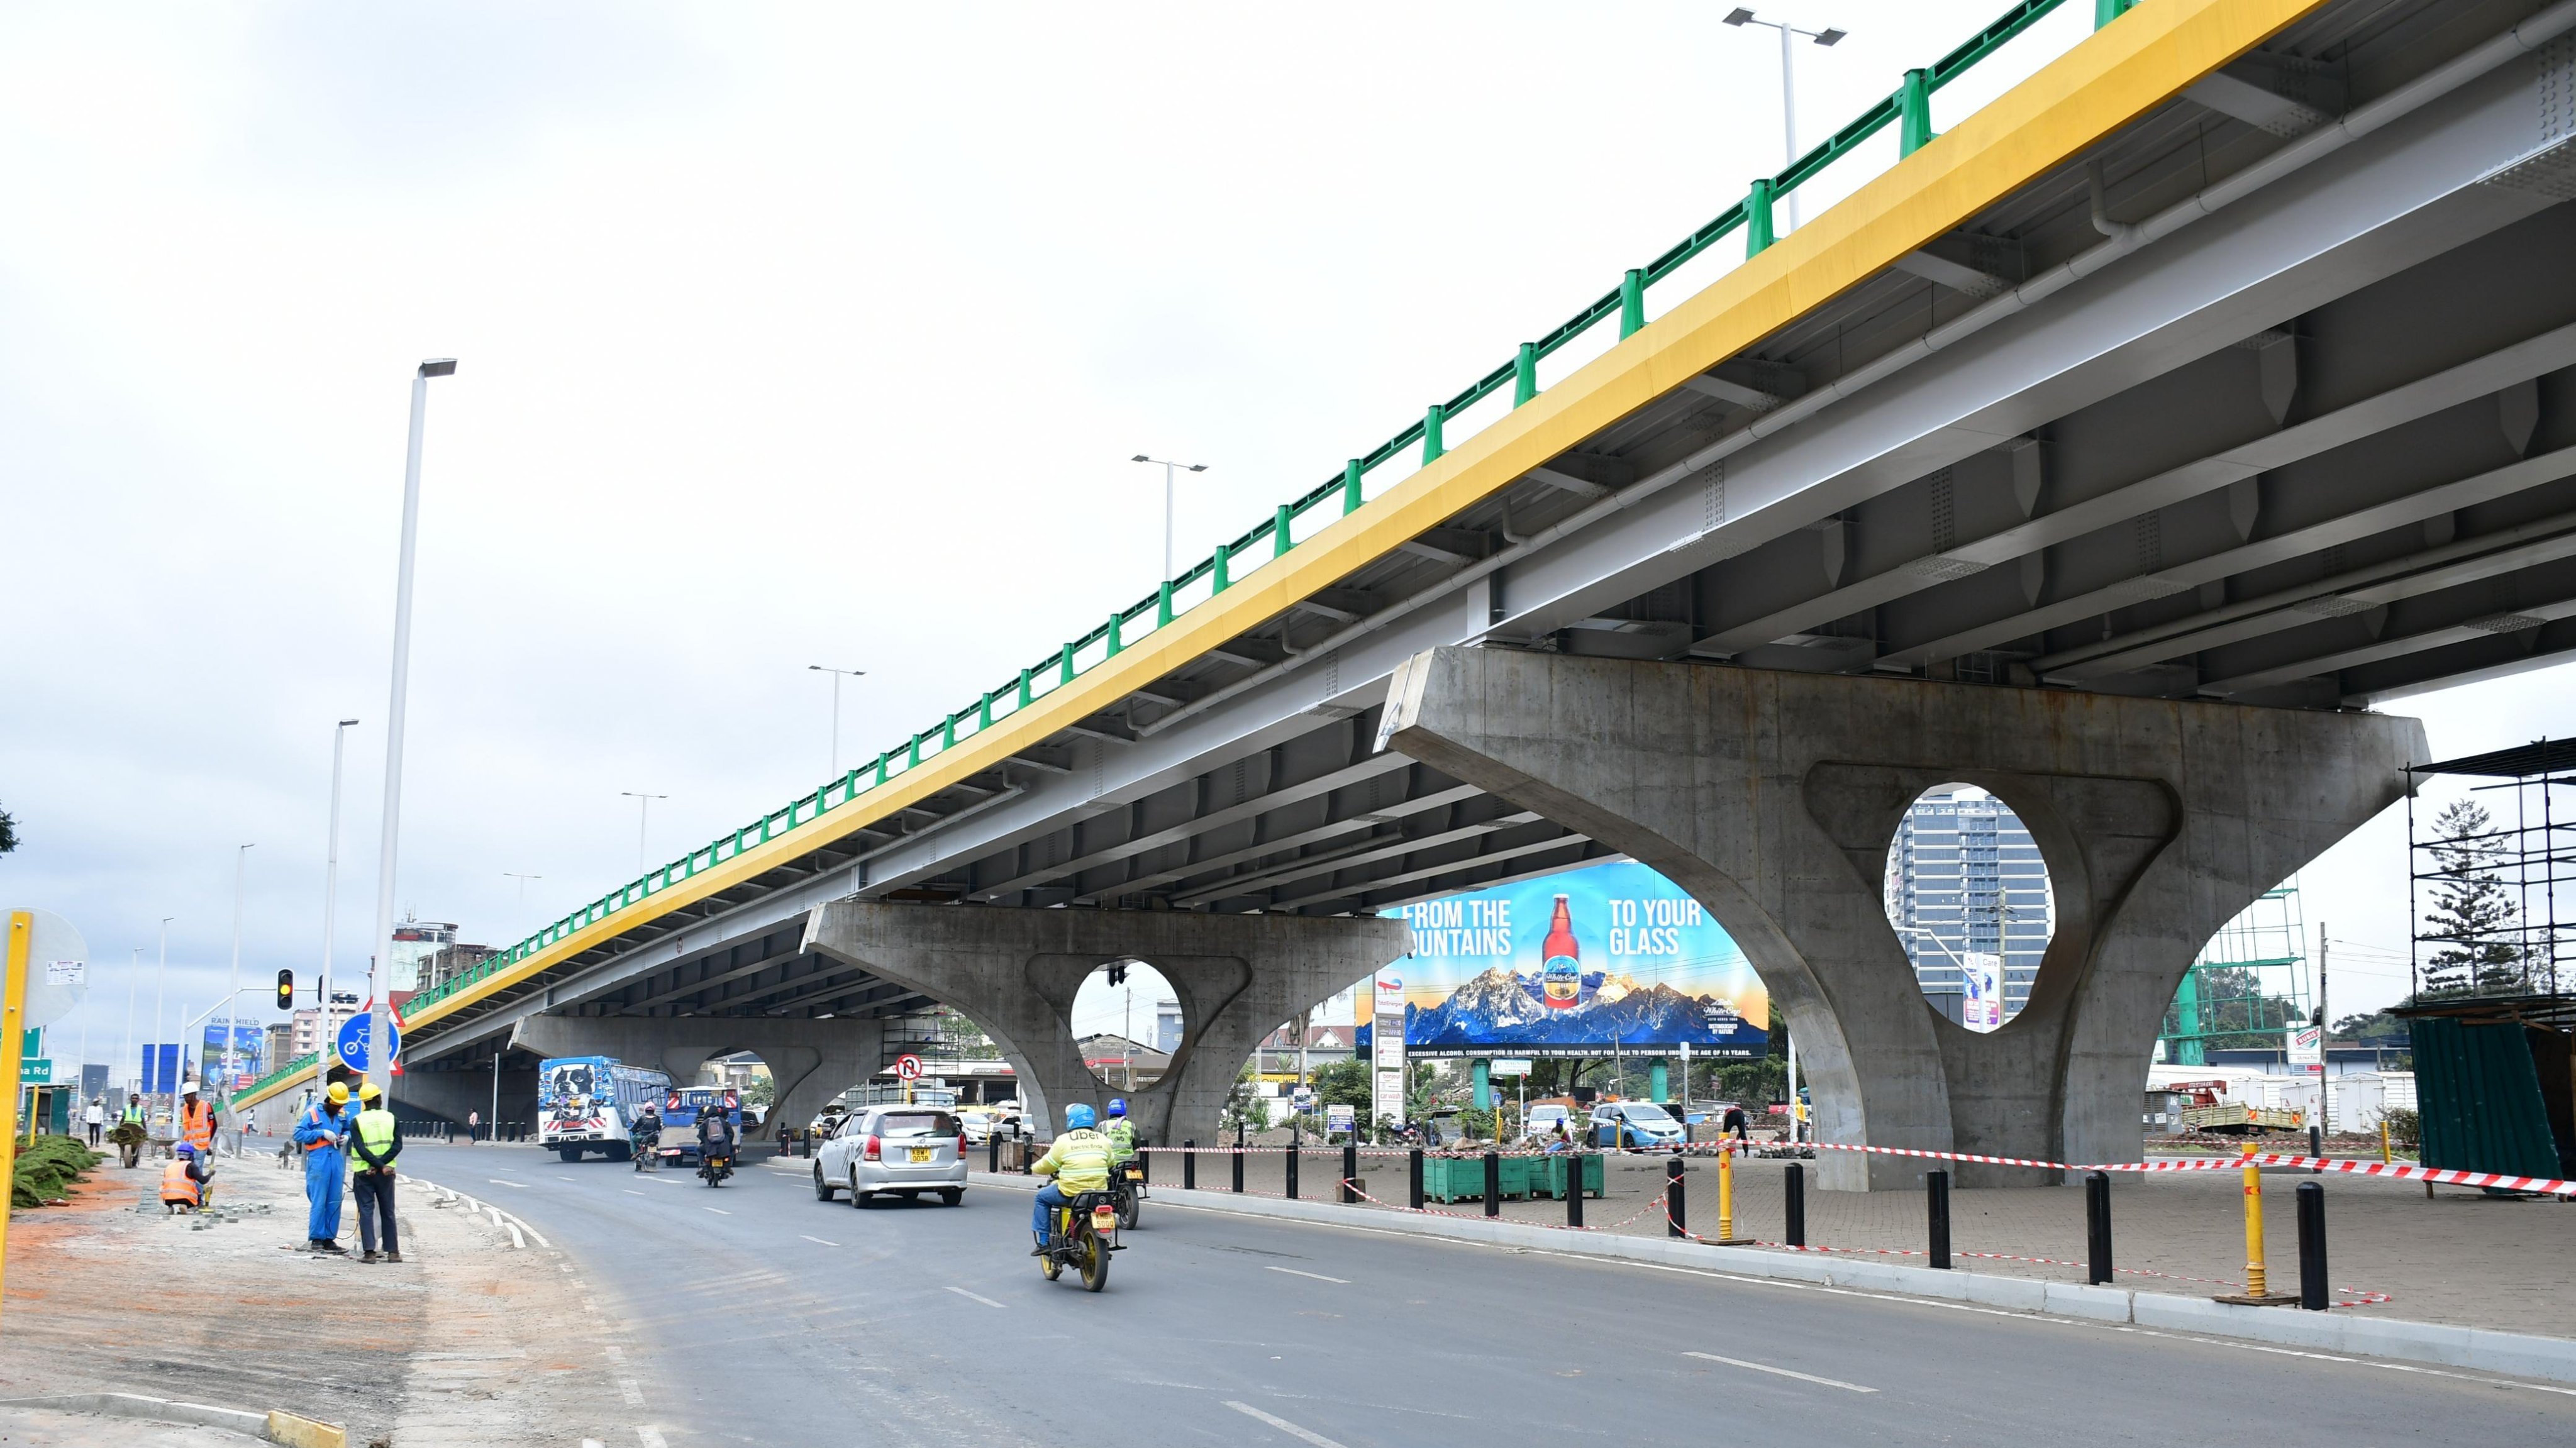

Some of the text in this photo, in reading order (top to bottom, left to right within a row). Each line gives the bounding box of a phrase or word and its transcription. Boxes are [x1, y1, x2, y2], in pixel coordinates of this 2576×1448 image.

[1468, 900, 1511, 927] THE
[1609, 899, 1701, 927] TO YOUR
[1609, 927, 1679, 955] GLASS
[1983, 958, 1997, 966] Care
[1726, 1006, 1741, 1016] Cap
[211, 1017, 259, 1025] RAINHIELD
[2298, 1031, 2317, 1044] RUBIS
[33, 1067, 48, 1075] Rd
[1069, 1130, 1099, 1141] Uber
